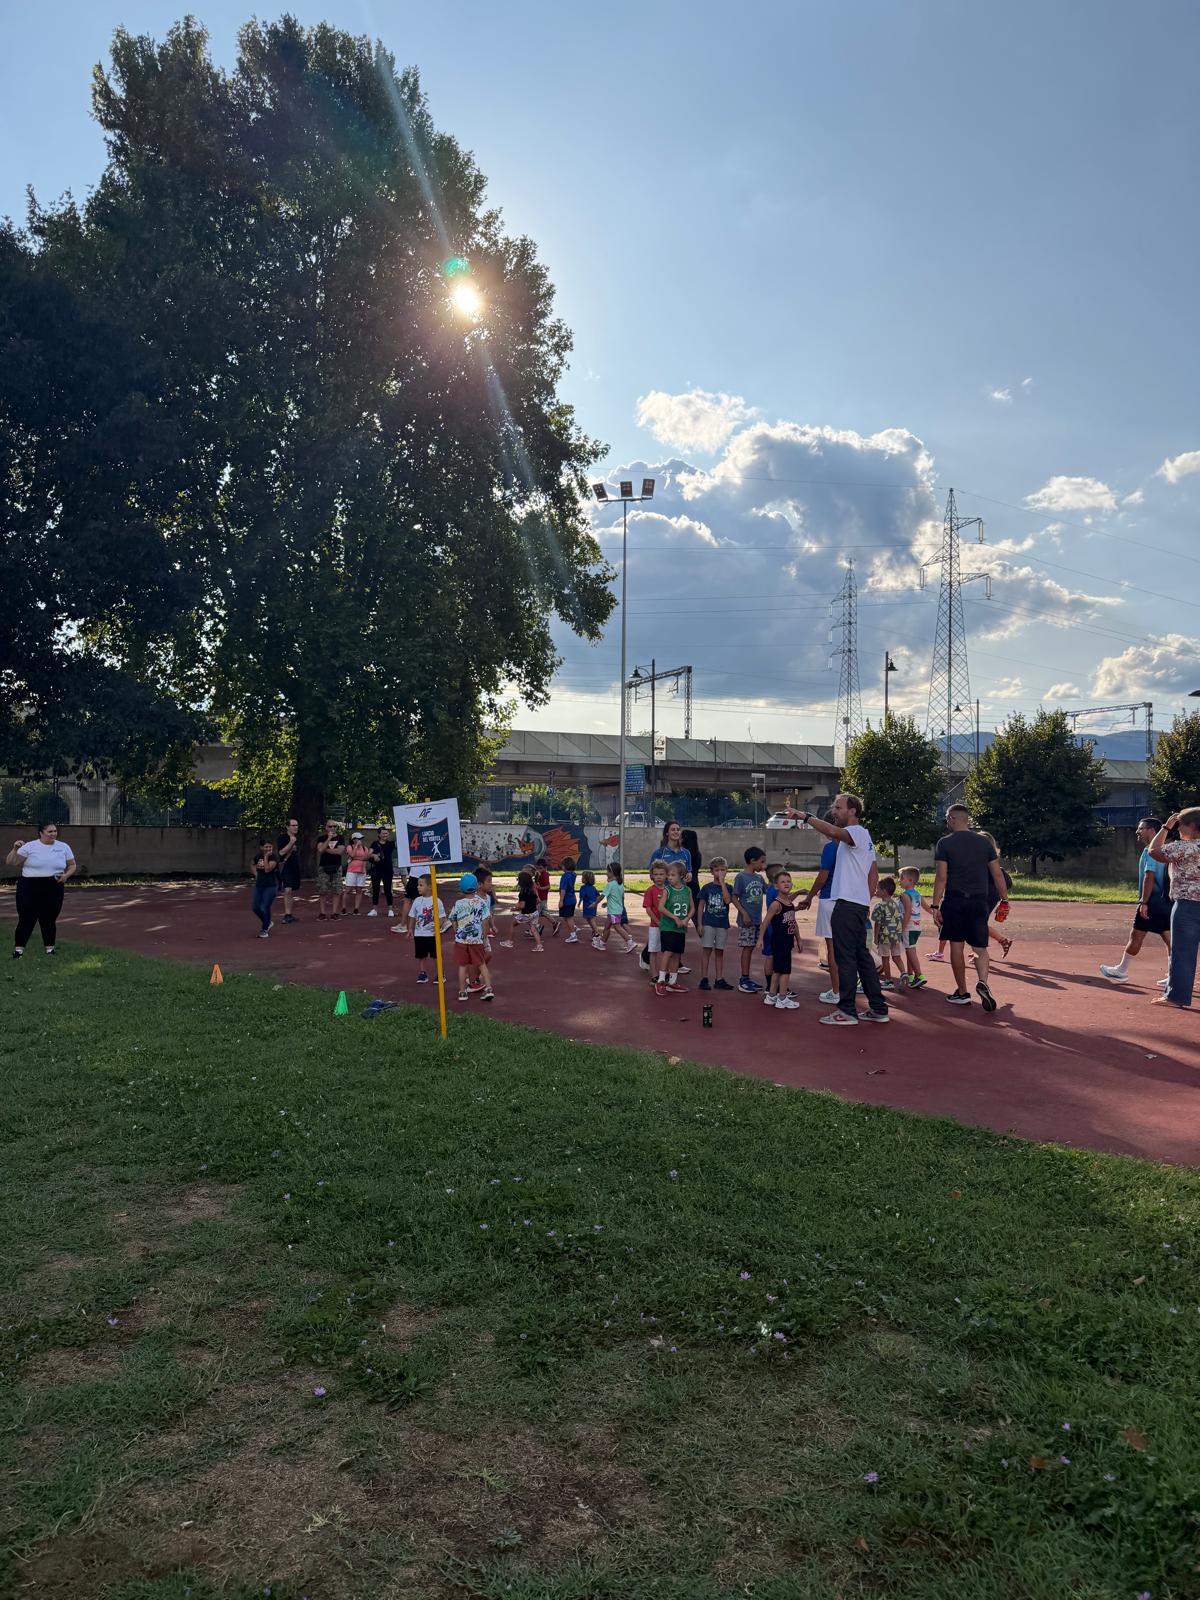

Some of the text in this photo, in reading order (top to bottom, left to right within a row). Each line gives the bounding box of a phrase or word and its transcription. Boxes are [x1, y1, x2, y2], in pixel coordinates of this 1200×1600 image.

[419, 807, 432, 818] AF
[410, 832, 420, 851] 4
[673, 902, 688, 916] 23
